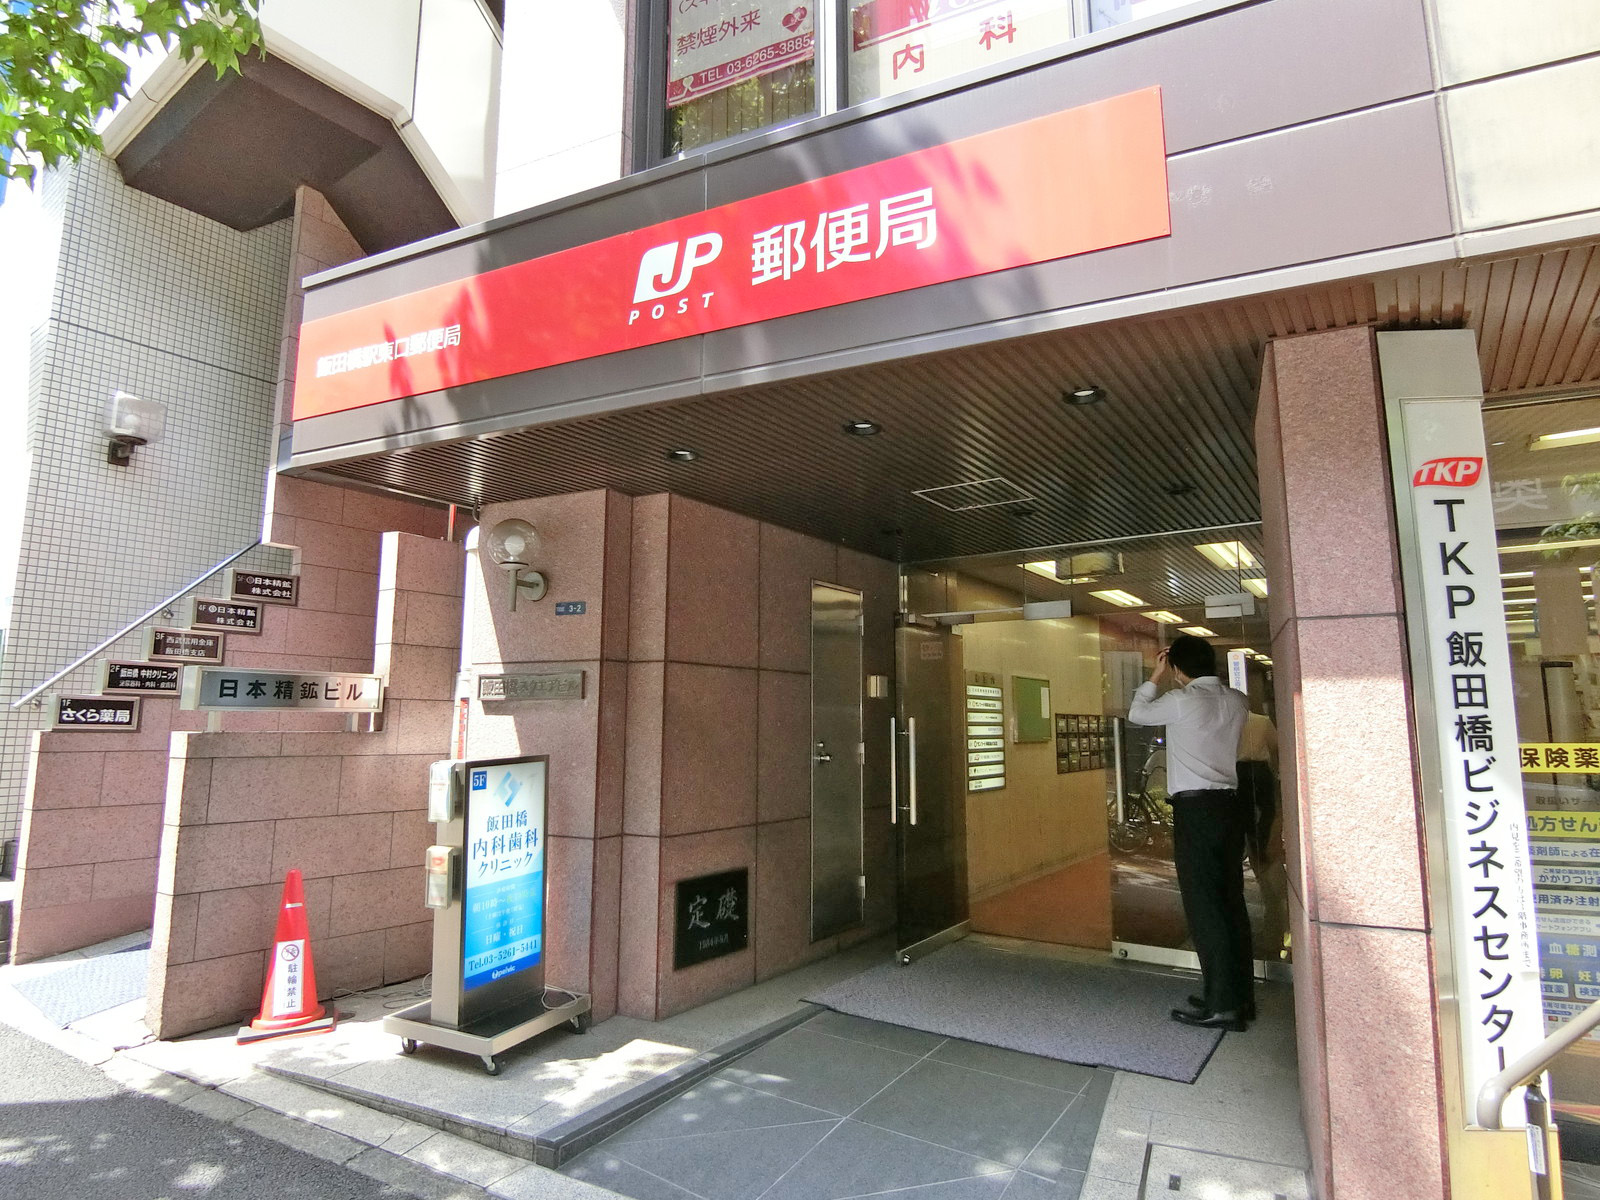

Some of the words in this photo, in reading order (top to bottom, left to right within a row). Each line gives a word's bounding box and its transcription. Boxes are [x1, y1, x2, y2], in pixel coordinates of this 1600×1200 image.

[677, 9, 760, 57] 禁煙外来
[700, 69, 724, 84] TEL
[726, 34, 811, 75] 03-6265-3885
[750, 187, 937, 286] 郵便局
[628, 292, 714, 325] POST
[1420, 460, 1478, 483] TKP
[251, 587, 291, 597] 株式会社
[216, 617, 254, 627] 株式会社
[156, 632, 165, 640] 3F
[166, 636, 213, 646] 西武信用金庫
[165, 648, 205, 656] 飯田橋支店
[110, 665, 119, 673] 2F
[218, 679, 363, 701] 日本精鉱ビル
[61, 708, 130, 723] さくら薬局
[473, 774, 486, 787] 5F
[487, 809, 527, 832] 飯田橋
[1526, 816, 1600, 832] 処方せん
[473, 828, 538, 860] 内科歯科
[479, 851, 533, 878] クリニック
[1539, 875, 1600, 885] かかりつけ
[688, 887, 739, 930] 定礎
[286, 963, 297, 1008] 駐輪禁止
